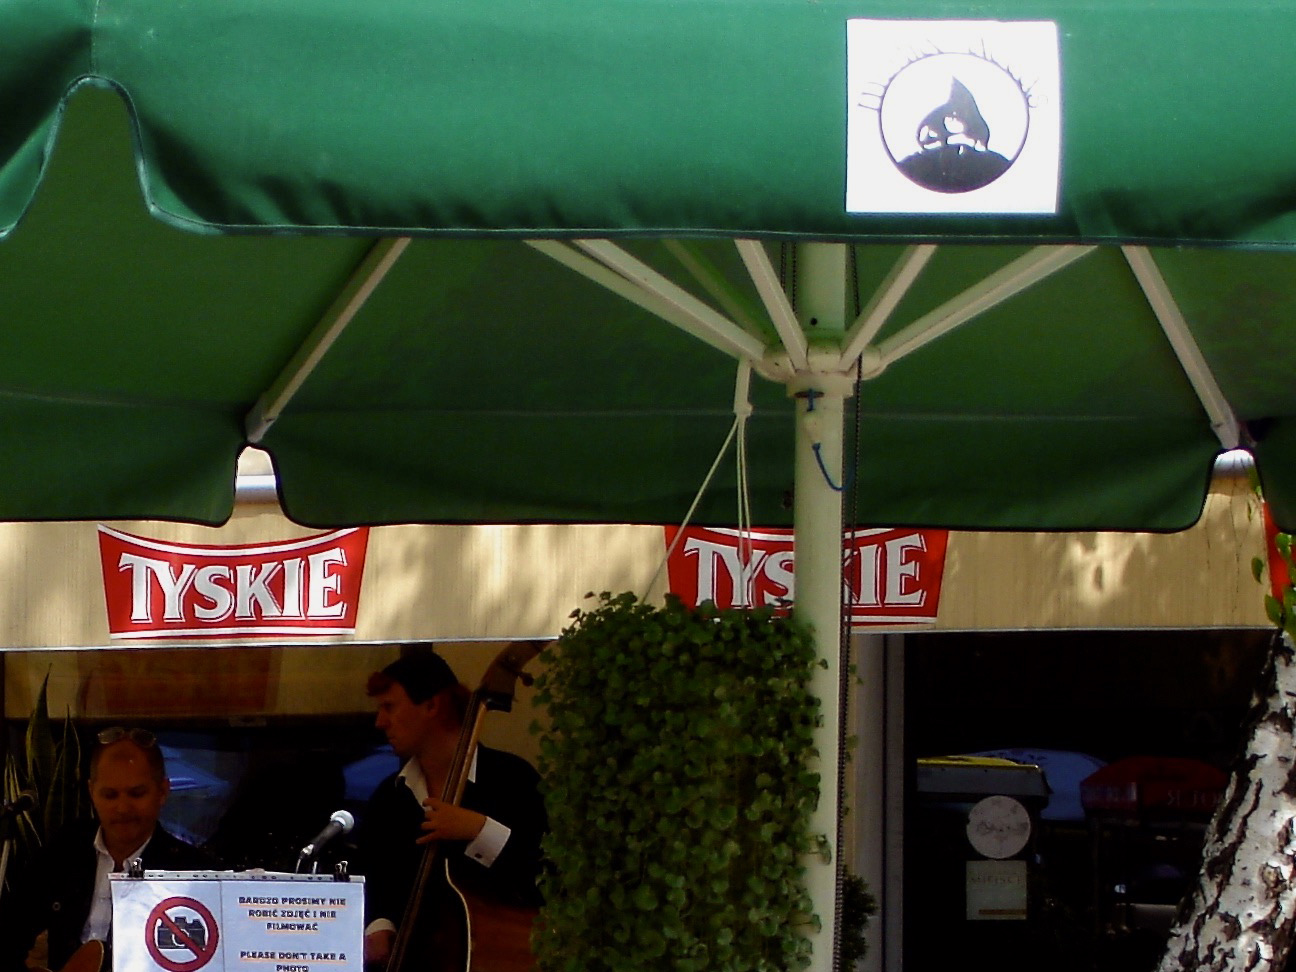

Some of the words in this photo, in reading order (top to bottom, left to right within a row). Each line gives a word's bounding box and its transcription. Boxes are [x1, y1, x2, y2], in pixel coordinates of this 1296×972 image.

[118, 547, 347, 623] TYSKIE
[238, 897, 279, 905] BARDZO
[281, 897, 326, 905] PROSIMY
[329, 898, 346, 906] NIE
[248, 909, 278, 918] ROBIĆ
[281, 908, 311, 920] ZDJĘĆ
[319, 910, 336, 918] NIE
[266, 922, 319, 931] FILMOWAĆ
[240, 951, 276, 959] PLEASE
[278, 951, 308, 960] DON'T
[310, 952, 336, 960] TAKE
[338, 952, 347, 960] A
[276, 964, 310, 972] PHOTO
